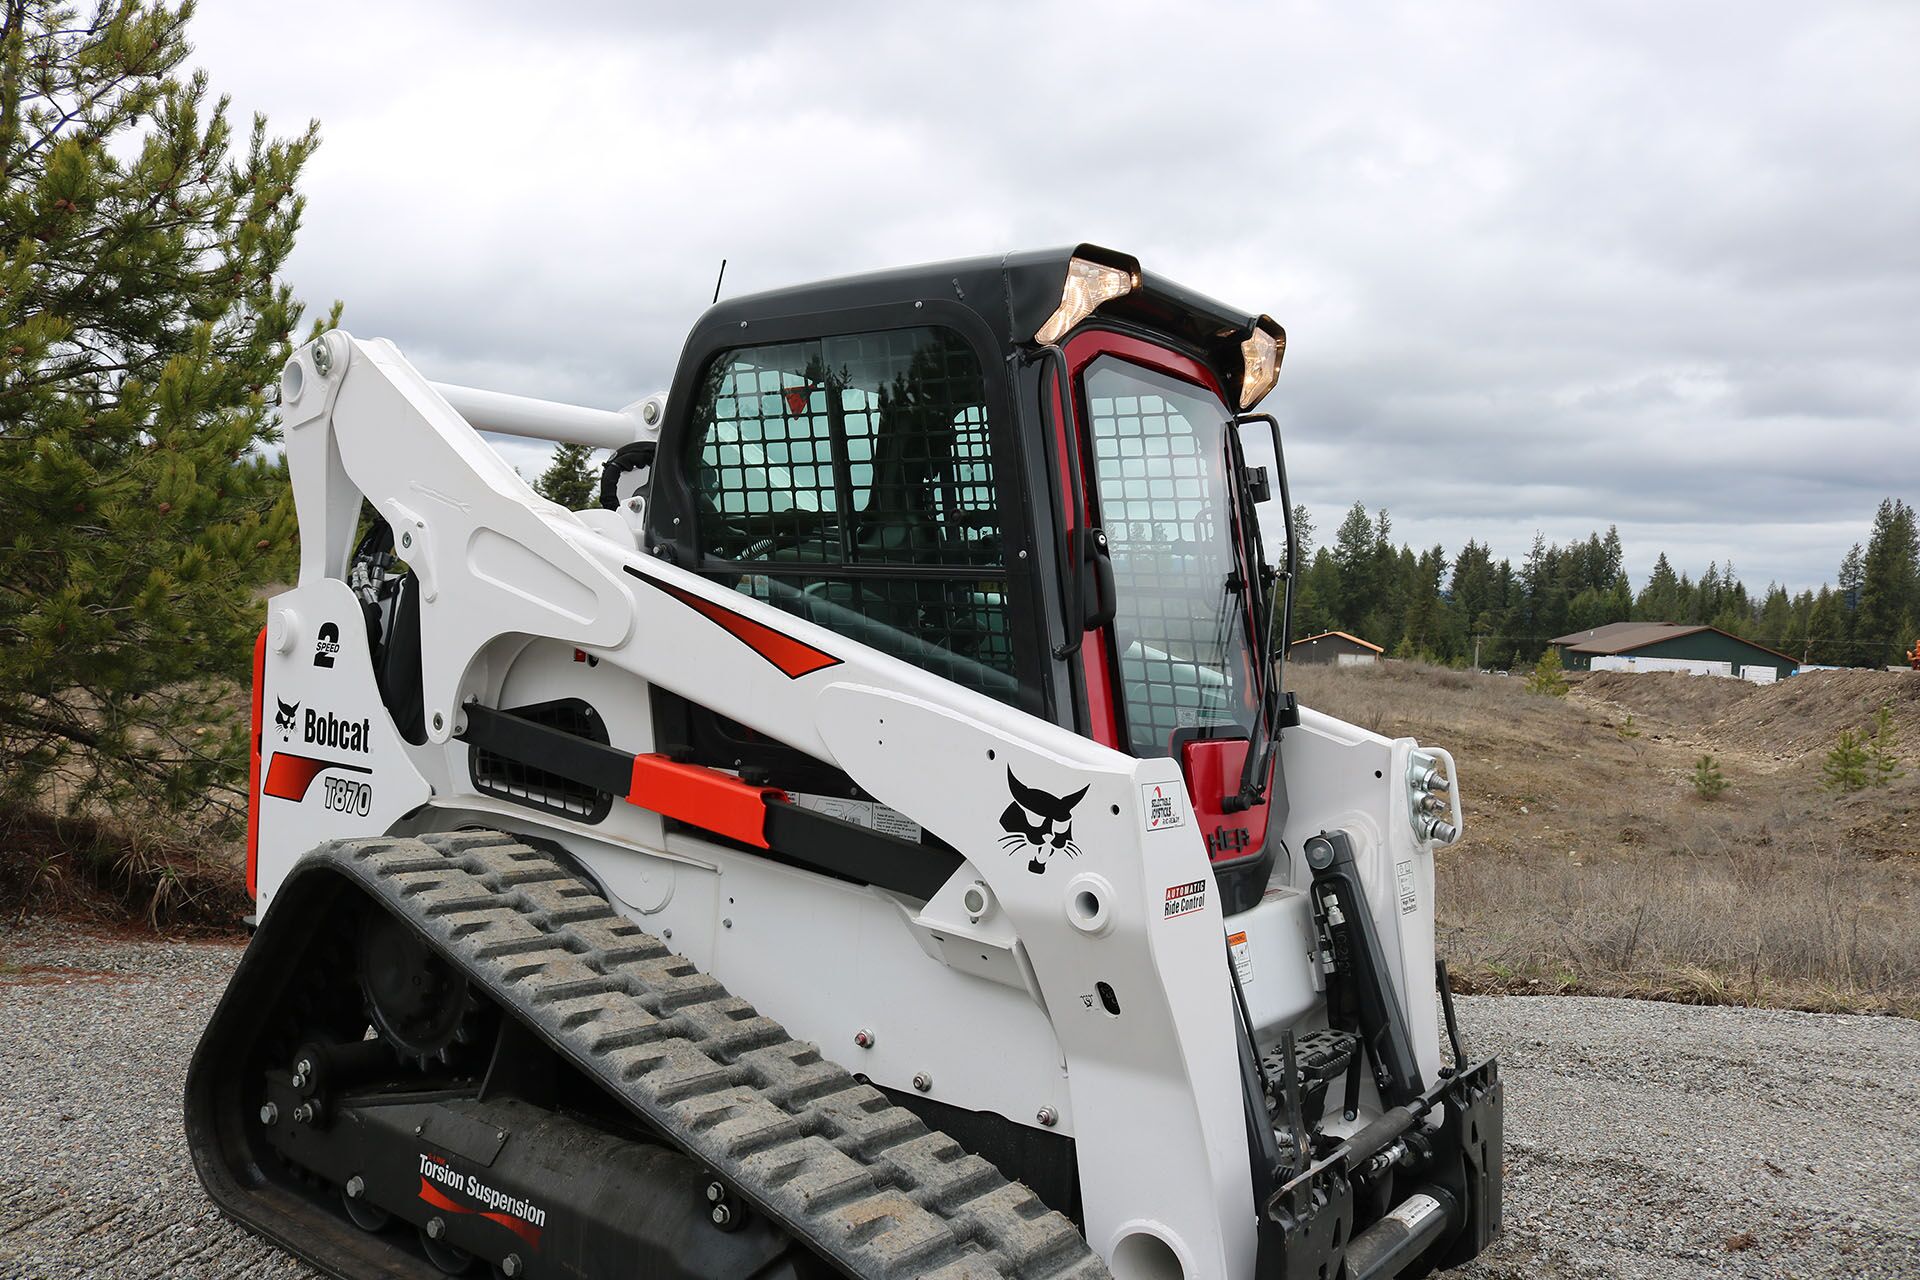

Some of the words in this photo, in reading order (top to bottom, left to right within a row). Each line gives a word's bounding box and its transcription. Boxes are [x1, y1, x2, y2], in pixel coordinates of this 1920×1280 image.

[314, 622, 340, 668] 2
[316, 642, 340, 653] SPEED
[304, 708, 370, 753] Bobcat
[325, 776, 372, 817] T870
[1164, 900, 1180, 916] Ride
[1180, 892, 1205, 912] Control
[1166, 881, 1205, 899] AUTOMATIC
[419, 1153, 465, 1191] Torsion
[466, 1175, 546, 1227] Suspension
